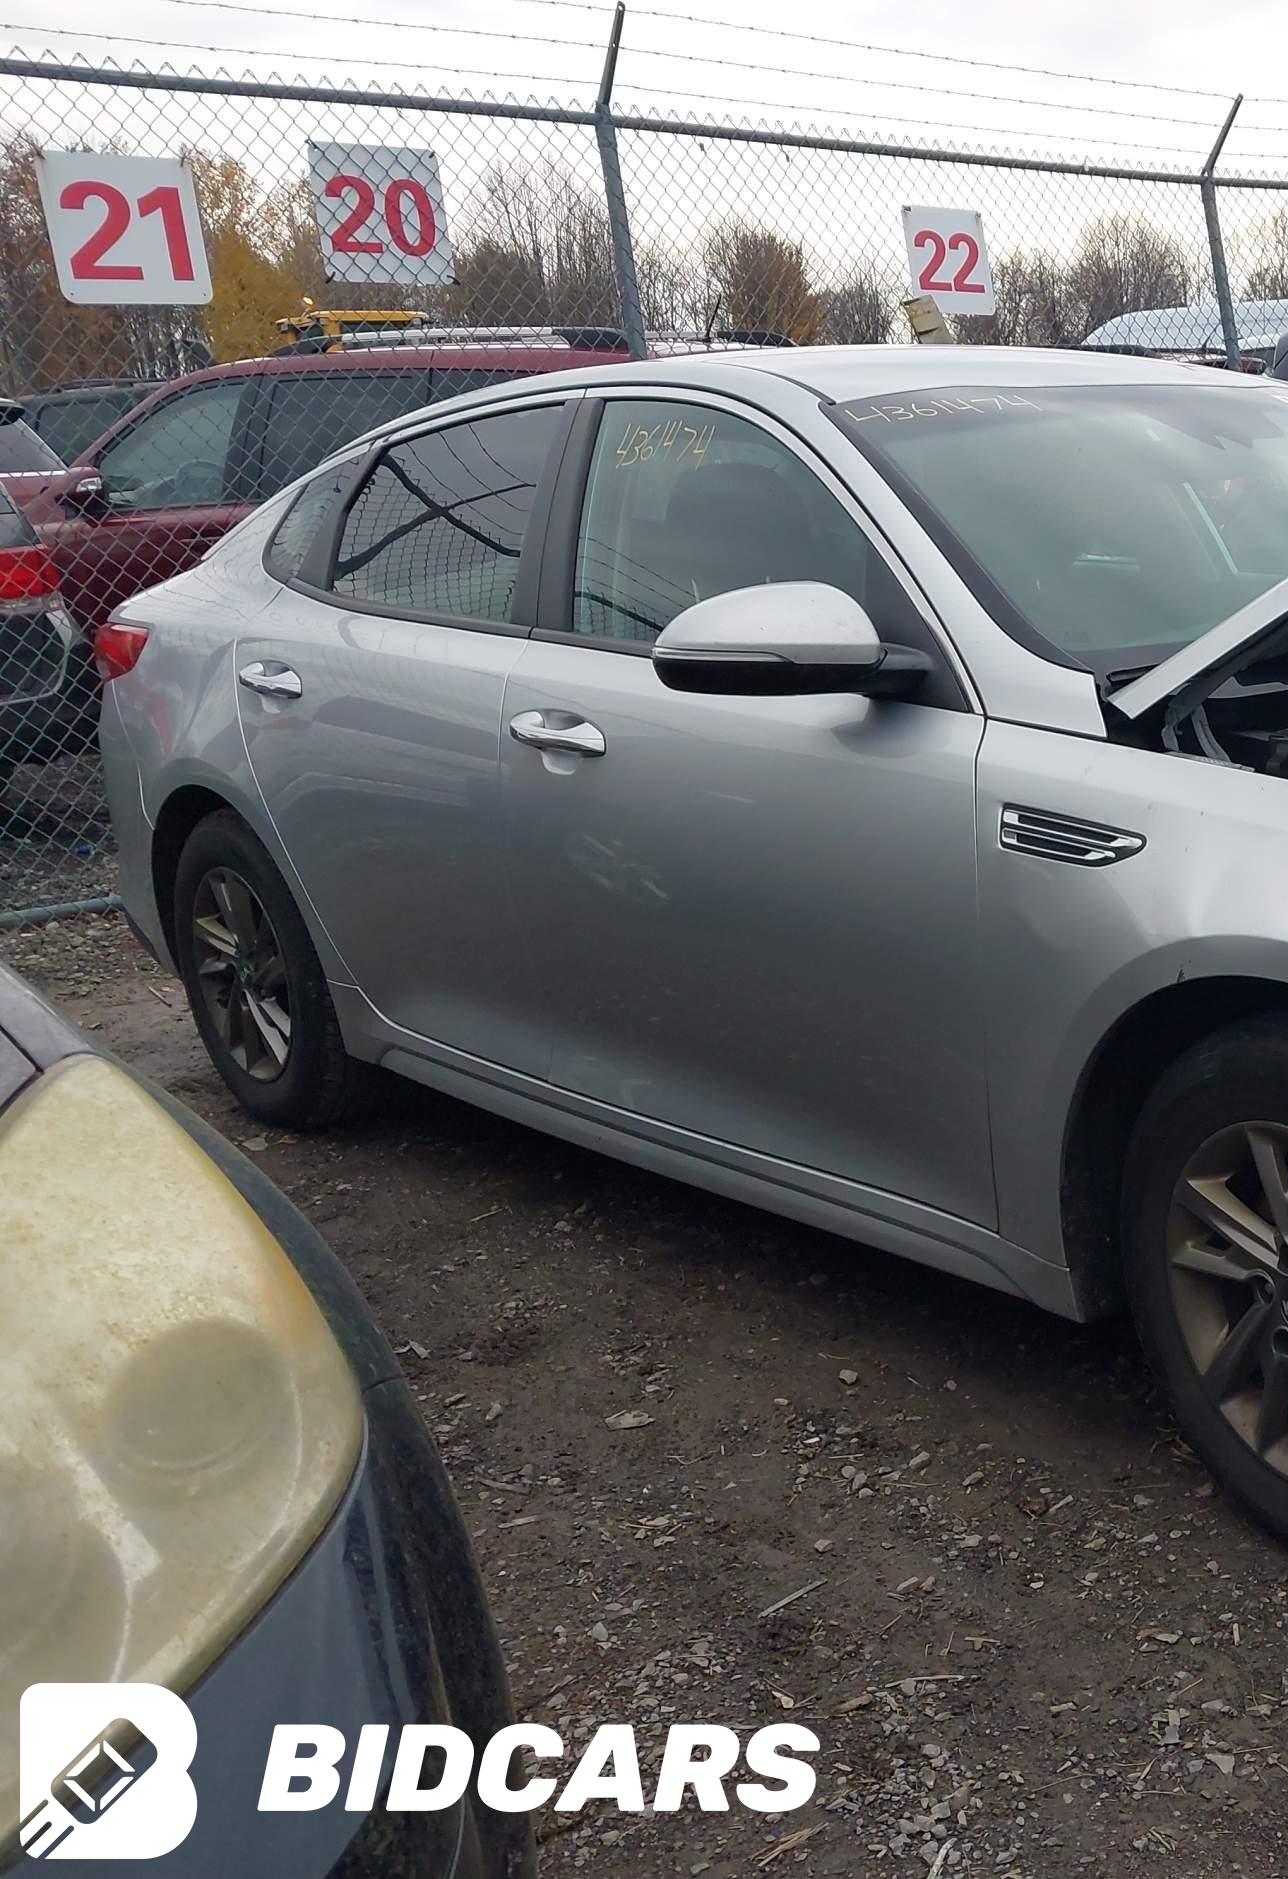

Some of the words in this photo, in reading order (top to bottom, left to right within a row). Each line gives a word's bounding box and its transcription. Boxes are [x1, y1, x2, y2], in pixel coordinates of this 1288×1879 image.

[60, 181, 194, 281] 21
[325, 175, 436, 257] 20
[914, 230, 985, 293] 22
[845, 394, 1043, 423] 4361474
